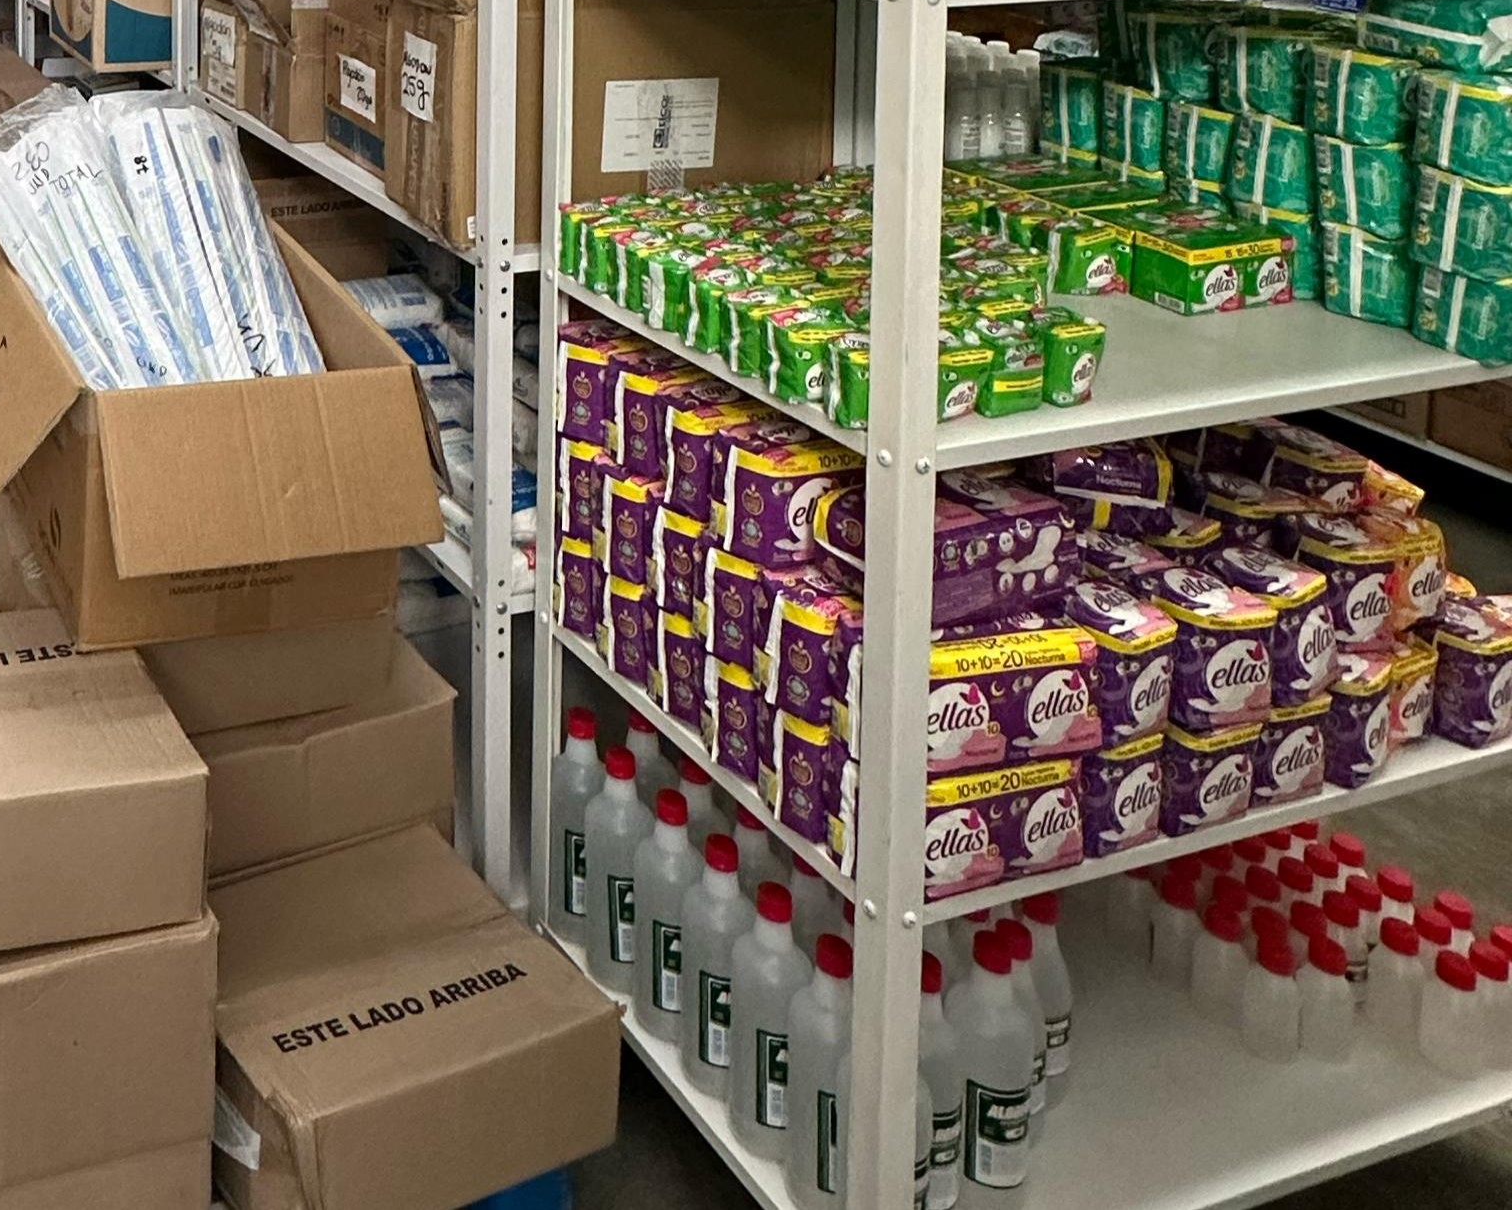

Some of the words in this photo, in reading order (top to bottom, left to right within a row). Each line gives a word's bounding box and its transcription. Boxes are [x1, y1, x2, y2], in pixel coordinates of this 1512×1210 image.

[1205, 276, 1236, 297] ellas
[1259, 268, 1287, 290] ellas
[955, 651, 1024, 673] 10+10=20
[1211, 662, 1268, 690] ellas
[928, 703, 987, 735] ellas
[1031, 688, 1086, 724] ellas
[1276, 741, 1323, 776] ellas
[956, 771, 1021, 799] 10+10=20
[1203, 769, 1252, 805] ellas
[1027, 805, 1077, 844] ellas
[926, 828, 986, 862] ellas
[272, 1018, 350, 1055] ESTE
[349, 994, 425, 1034] LADO
[429, 961, 529, 1010] ARRIBA
